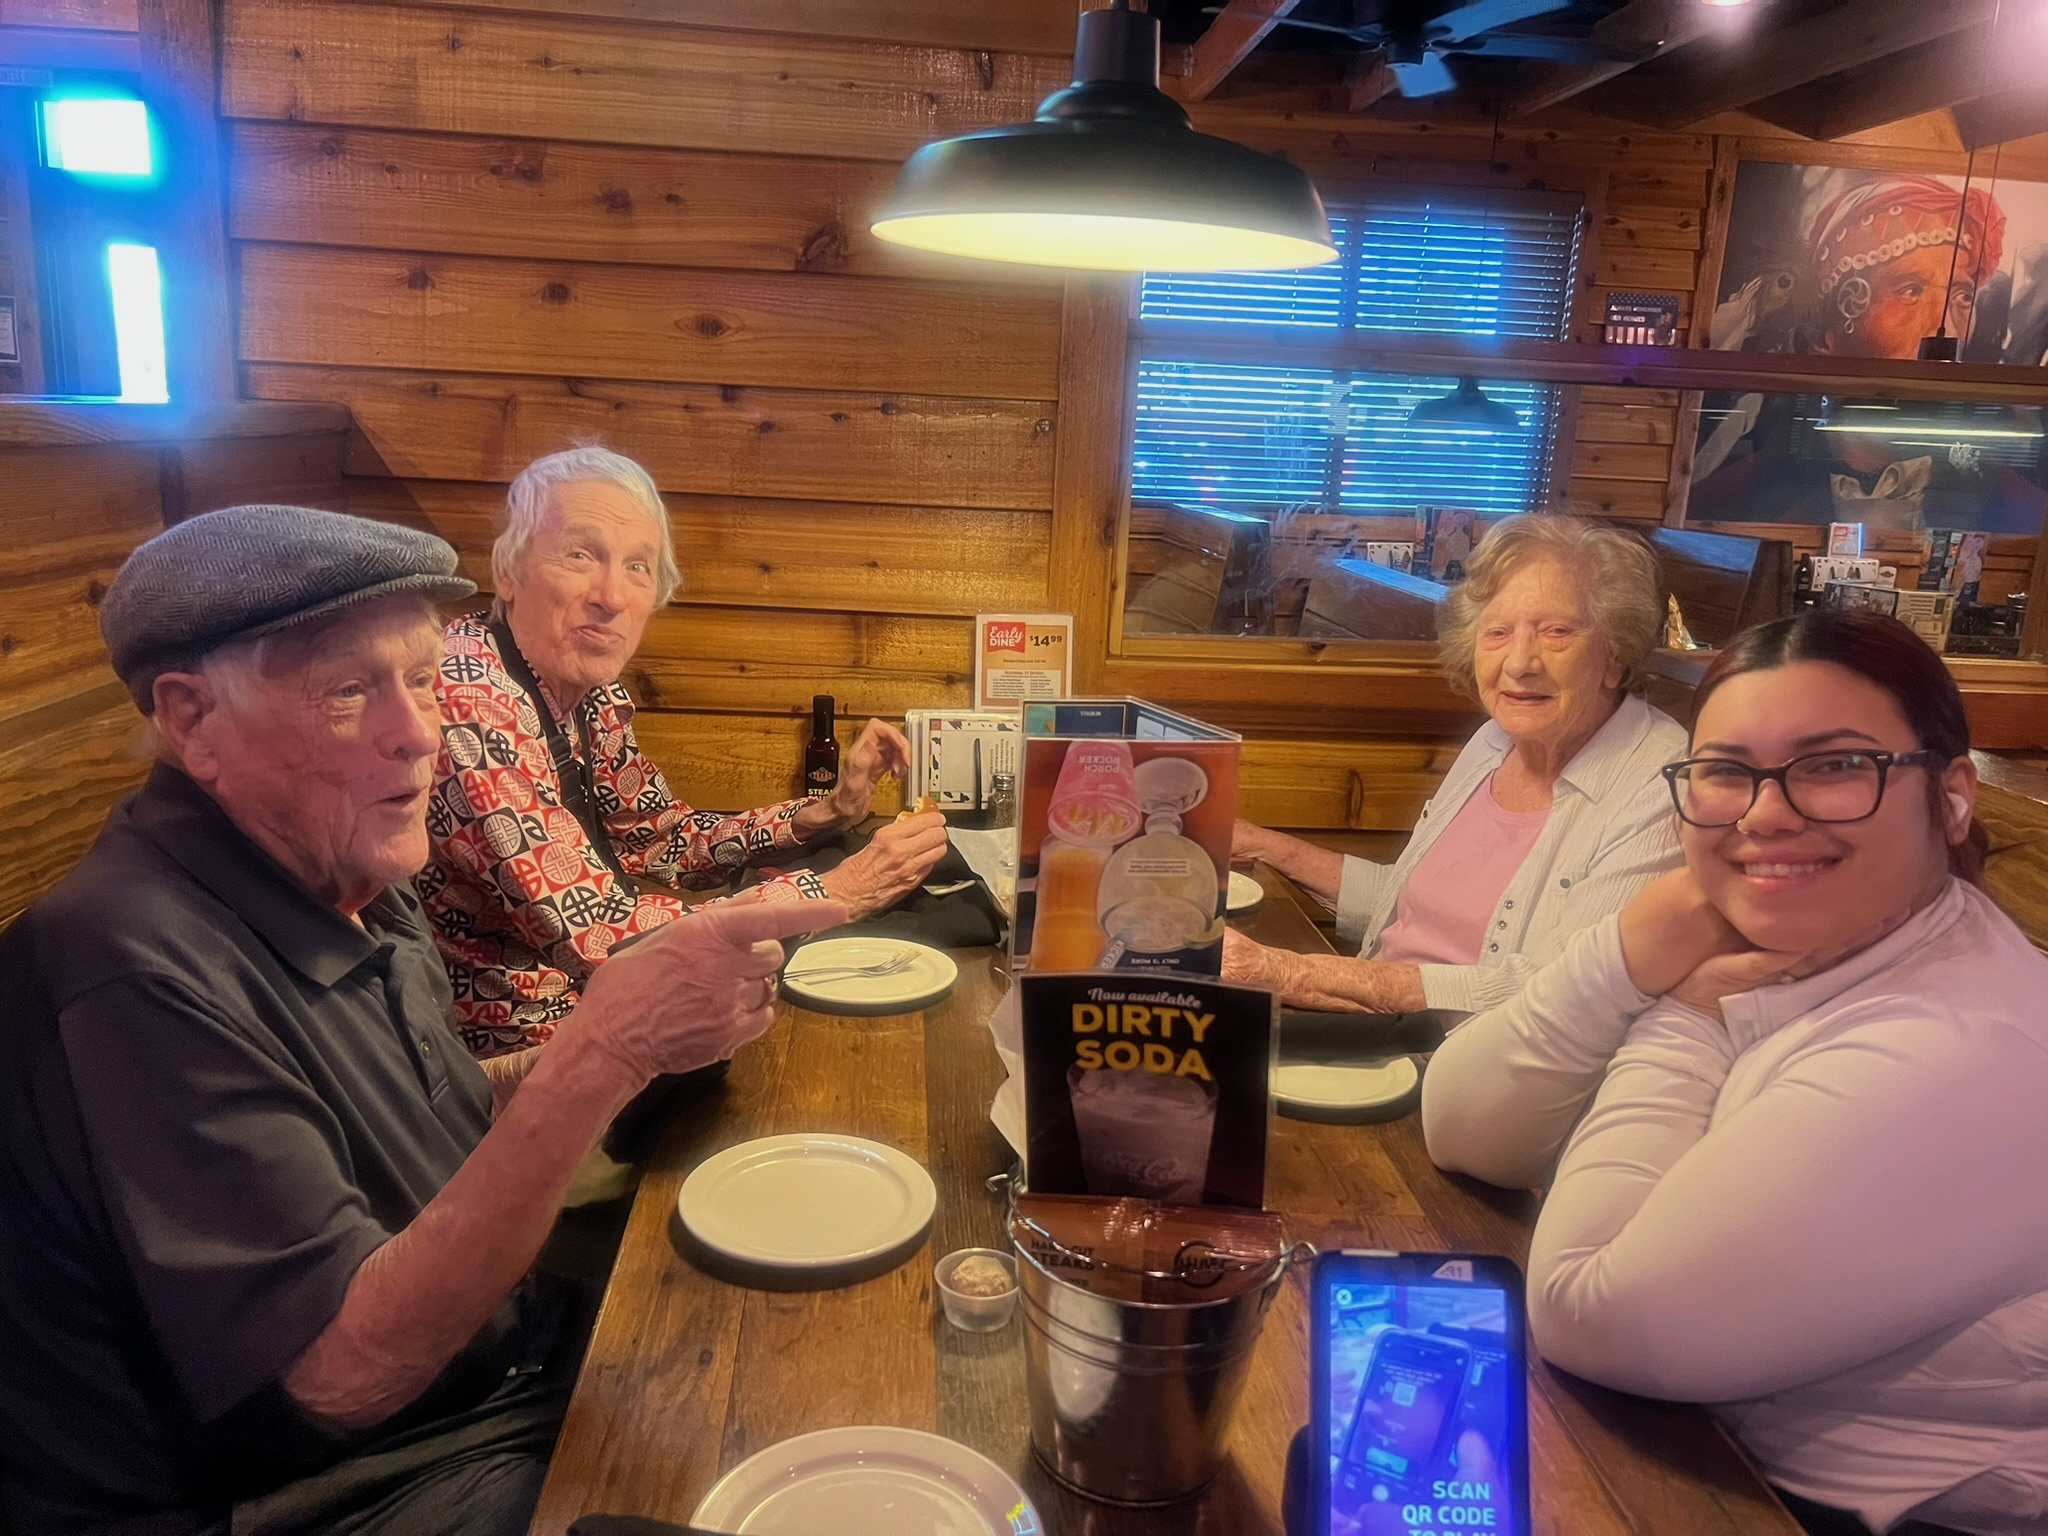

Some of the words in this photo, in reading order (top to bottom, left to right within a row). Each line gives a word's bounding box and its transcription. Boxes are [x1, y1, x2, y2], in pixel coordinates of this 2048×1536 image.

[989, 626, 1023, 643] Early
[989, 638, 1016, 647] DINE
[1078, 755, 1120, 765] ROCKER
[1084, 764, 1120, 773] PORCH
[1087, 987, 1126, 1002] Now
[1128, 991, 1202, 1009] available
[1072, 1003, 1215, 1042] DIRTY
[1075, 1040, 1214, 1081] SODA
[1433, 1480, 1490, 1500] SCAN
[1402, 1504, 1433, 1526] QR
[1438, 1506, 1496, 1526] CODE
